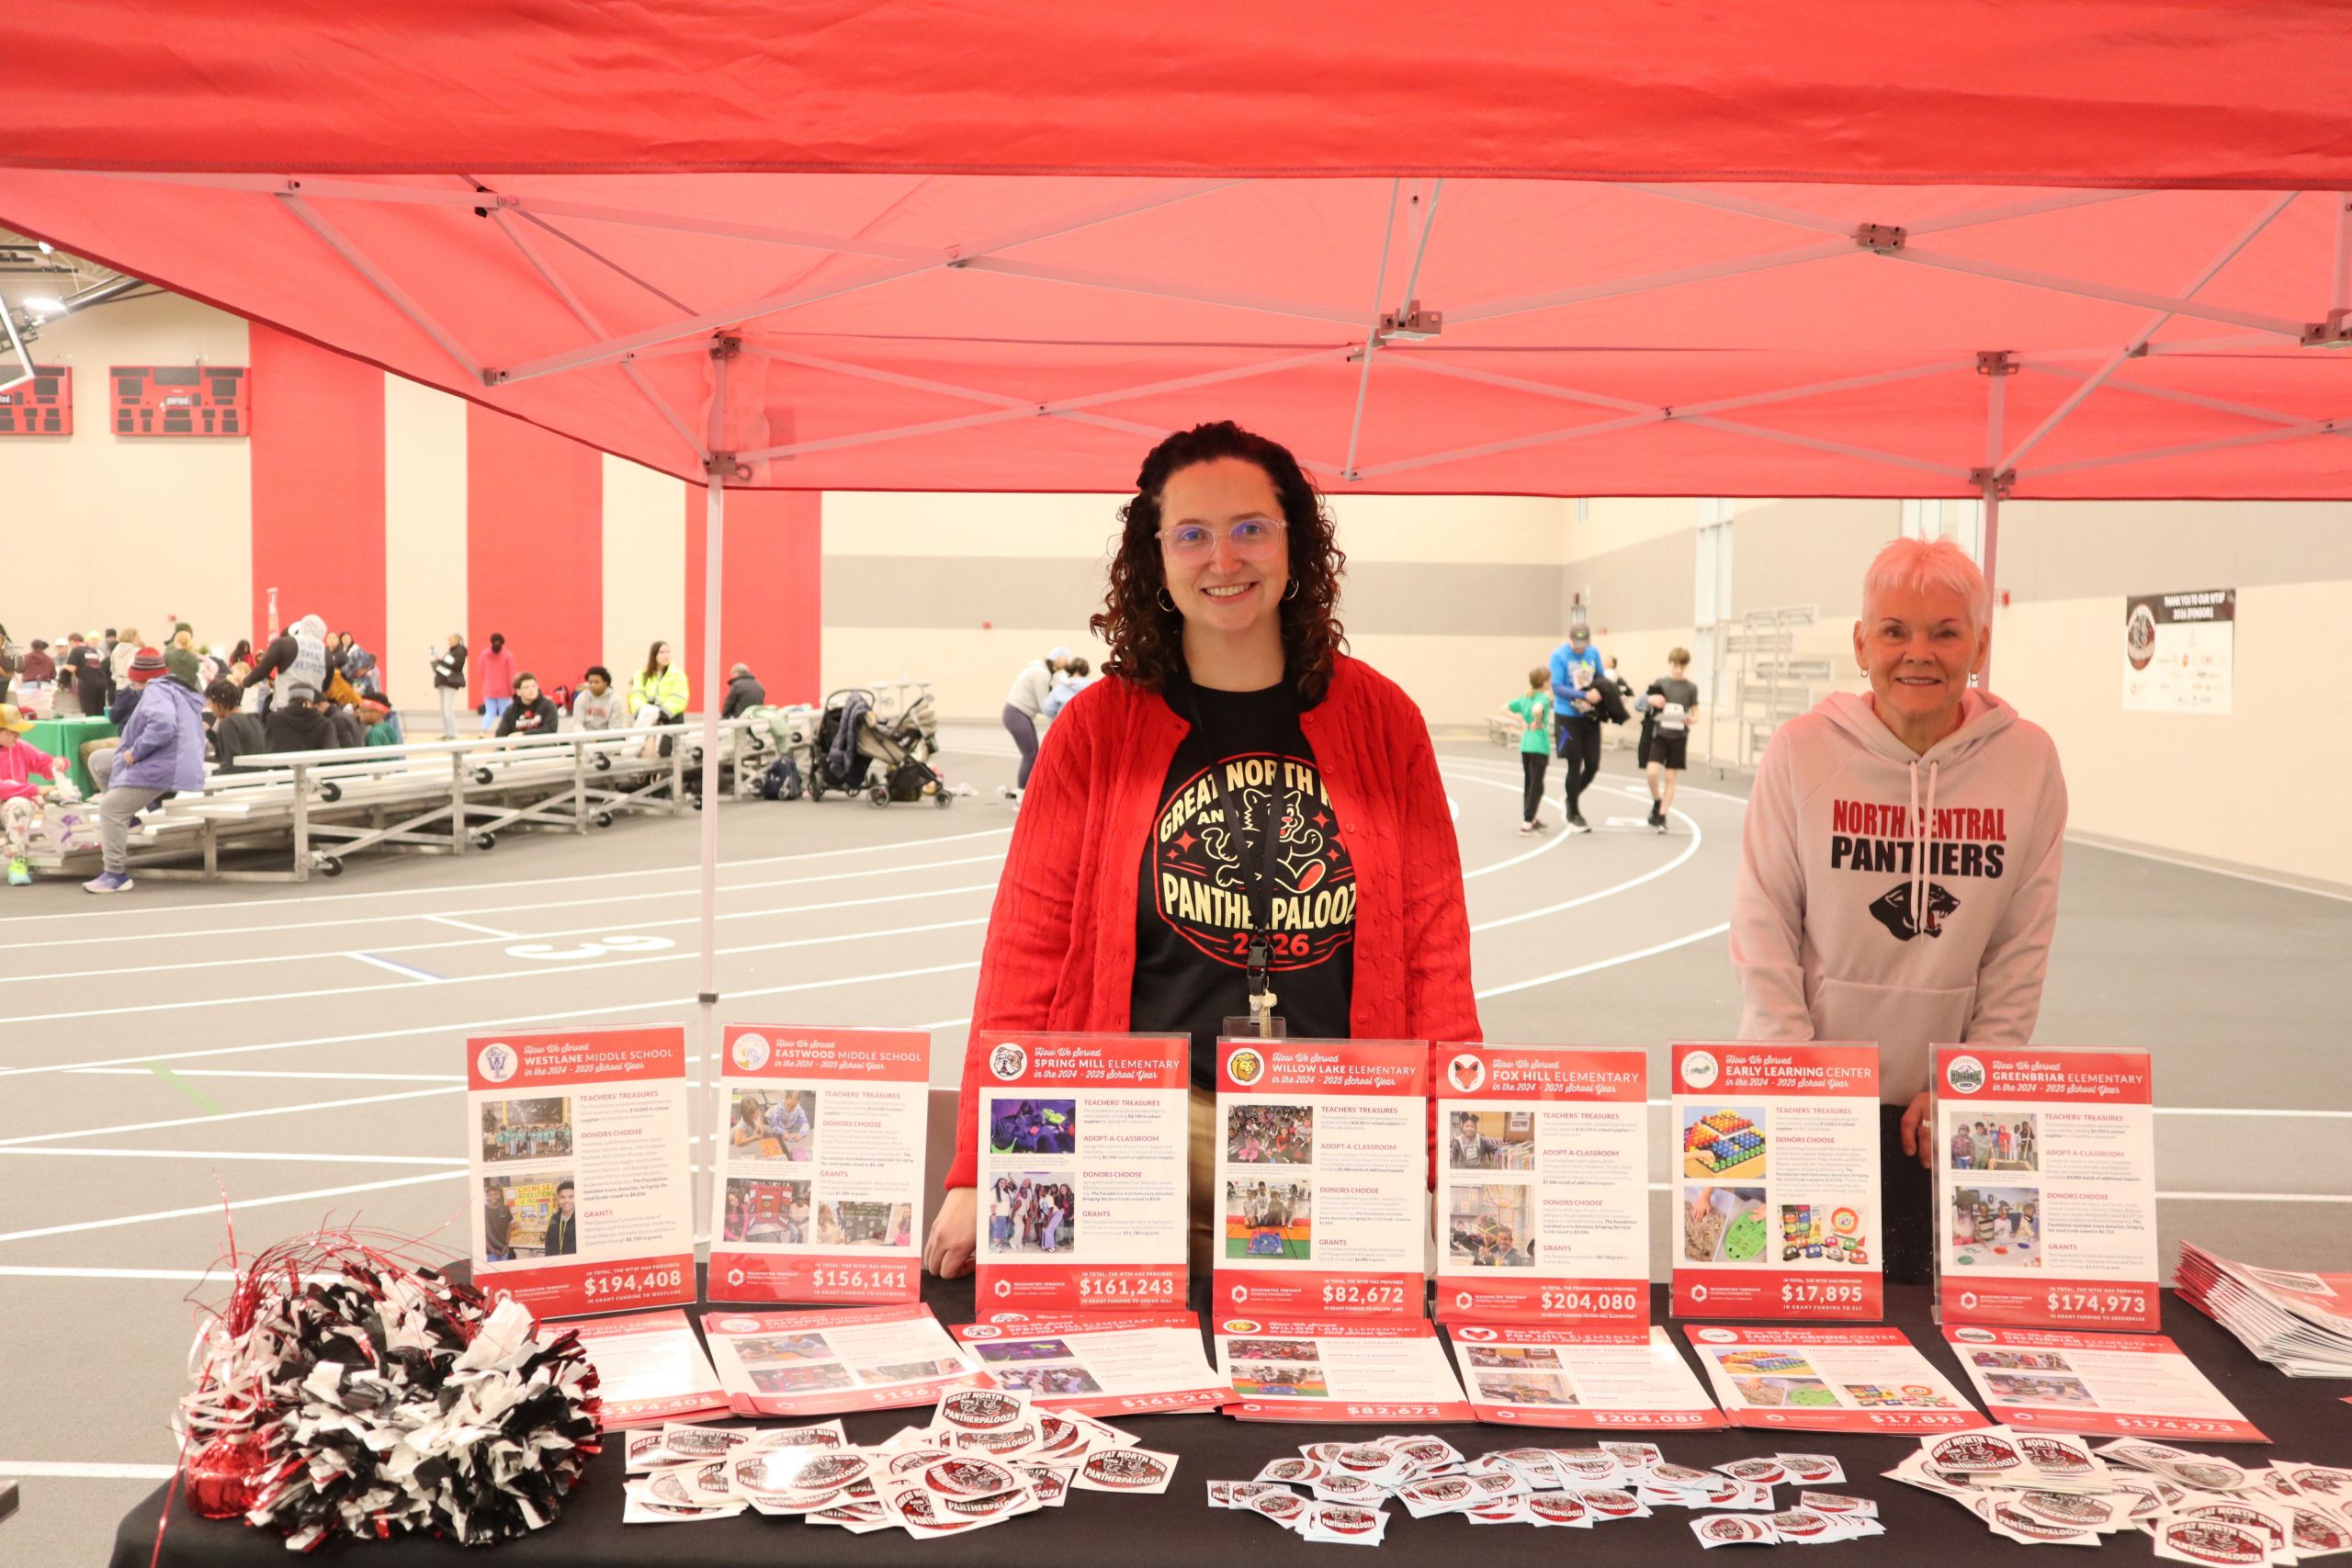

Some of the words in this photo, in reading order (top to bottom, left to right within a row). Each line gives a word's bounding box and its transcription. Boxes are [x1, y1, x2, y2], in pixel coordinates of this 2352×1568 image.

[1197, 809, 1238, 825] AN
[1833, 799, 1905, 838] NORTH
[1162, 873, 1355, 931] PANTHEPALOOZ
[1233, 932, 1309, 956] 226
[525, 1055, 582, 1066] WESTLANE
[586, 1052, 627, 1062] MIDDLE
[630, 1049, 673, 1059] SCHOOL
[775, 1049, 834, 1059] EASTWOOD
[838, 1051, 876, 1060] MIDDLE
[880, 1053, 922, 1062] SCHOOL
[1035, 1047, 1056, 1056] How
[1057, 1047, 1071, 1056] We
[1072, 1047, 1102, 1057] Served
[1272, 1053, 1294, 1063] How
[1295, 1053, 1309, 1062] We
[1310, 1053, 1340, 1063] Served
[1035, 1059, 1076, 1068] SPRING
[1079, 1059, 1104, 1068] MILL
[1108, 1060, 1181, 1069] ELEMENTARY
[1492, 1059, 1514, 1069] How
[1516, 1059, 1530, 1068] We
[1530, 1059, 1560, 1069] Served
[1725, 1055, 1747, 1065] How
[1748, 1055, 1762, 1064] We
[1764, 1055, 1793, 1065] Served
[1043, 1069, 1056, 1077] the
[1057, 1070, 1077, 1078] 2024
[1086, 1070, 1105, 1078] 2025
[1106, 1069, 1135, 1079] School
[1135, 1071, 1158, 1081] Year
[1272, 1064, 1316, 1073] WILLOW
[1319, 1066, 1346, 1074] LAKE
[1350, 1066, 1416, 1075] ELEMENTARY
[1493, 1071, 1519, 1080] FOX
[1523, 1071, 1551, 1081] HILL
[1555, 1072, 1639, 1083] ELEMENTARY
[1726, 1066, 1762, 1076] EARLY
[1765, 1066, 1824, 1077] LEARNING
[1826, 1067, 1872, 1077] CENTER
[1272, 1076, 1280, 1084] in
[1282, 1076, 1295, 1084] the
[1295, 1076, 1315, 1084] 2024
[1323, 1077, 1343, 1085] 2025
[1344, 1076, 1373, 1086] School
[1374, 1077, 1396, 1088] Year
[1736, 1077, 1747, 1086] the
[1748, 1077, 1769, 1086] 2024
[1777, 1078, 1797, 1087] 2025
[1798, 1078, 1826, 1088] School
[1827, 1079, 1849, 1089] Year
[1993, 1072, 2065, 1082] GREENBRIAR
[2068, 1073, 2143, 1084] ELEMENTARY
[1501, 1082, 1515, 1090] the
[1516, 1083, 1535, 1091] 2024
[1544, 1084, 1564, 1092] 2025
[1565, 1083, 1594, 1093] School
[1595, 1085, 1617, 1095] Year
[584, 1210, 614, 1218] GRANTS
[584, 1269, 681, 1296] $194,408
[812, 1269, 907, 1289] $156,141
[1080, 1277, 1173, 1297] $161,243
[1323, 1284, 1404, 1304] $82,672
[1781, 1284, 1863, 1304] $17,895
[1542, 1292, 1636, 1313] $204,080
[2047, 1292, 2146, 1314] $174,973
[947, 1393, 972, 1404] GREAT
[972, 1392, 1001, 1401] NORTH
[1002, 1395, 1020, 1408] RUN
[944, 1409, 1016, 1424] PANTHERPALOOZA
[1933, 1438, 1952, 1457] GREAT
[1953, 1435, 1984, 1445] NORTH
[1987, 1438, 2012, 1450] RUN
[1090, 1451, 1114, 1462] GREAT
[1117, 1450, 1148, 1461] NORTH
[1148, 1458, 1167, 1471] RUN
[1084, 1468, 1161, 1484] PANTHERPALOOZA
